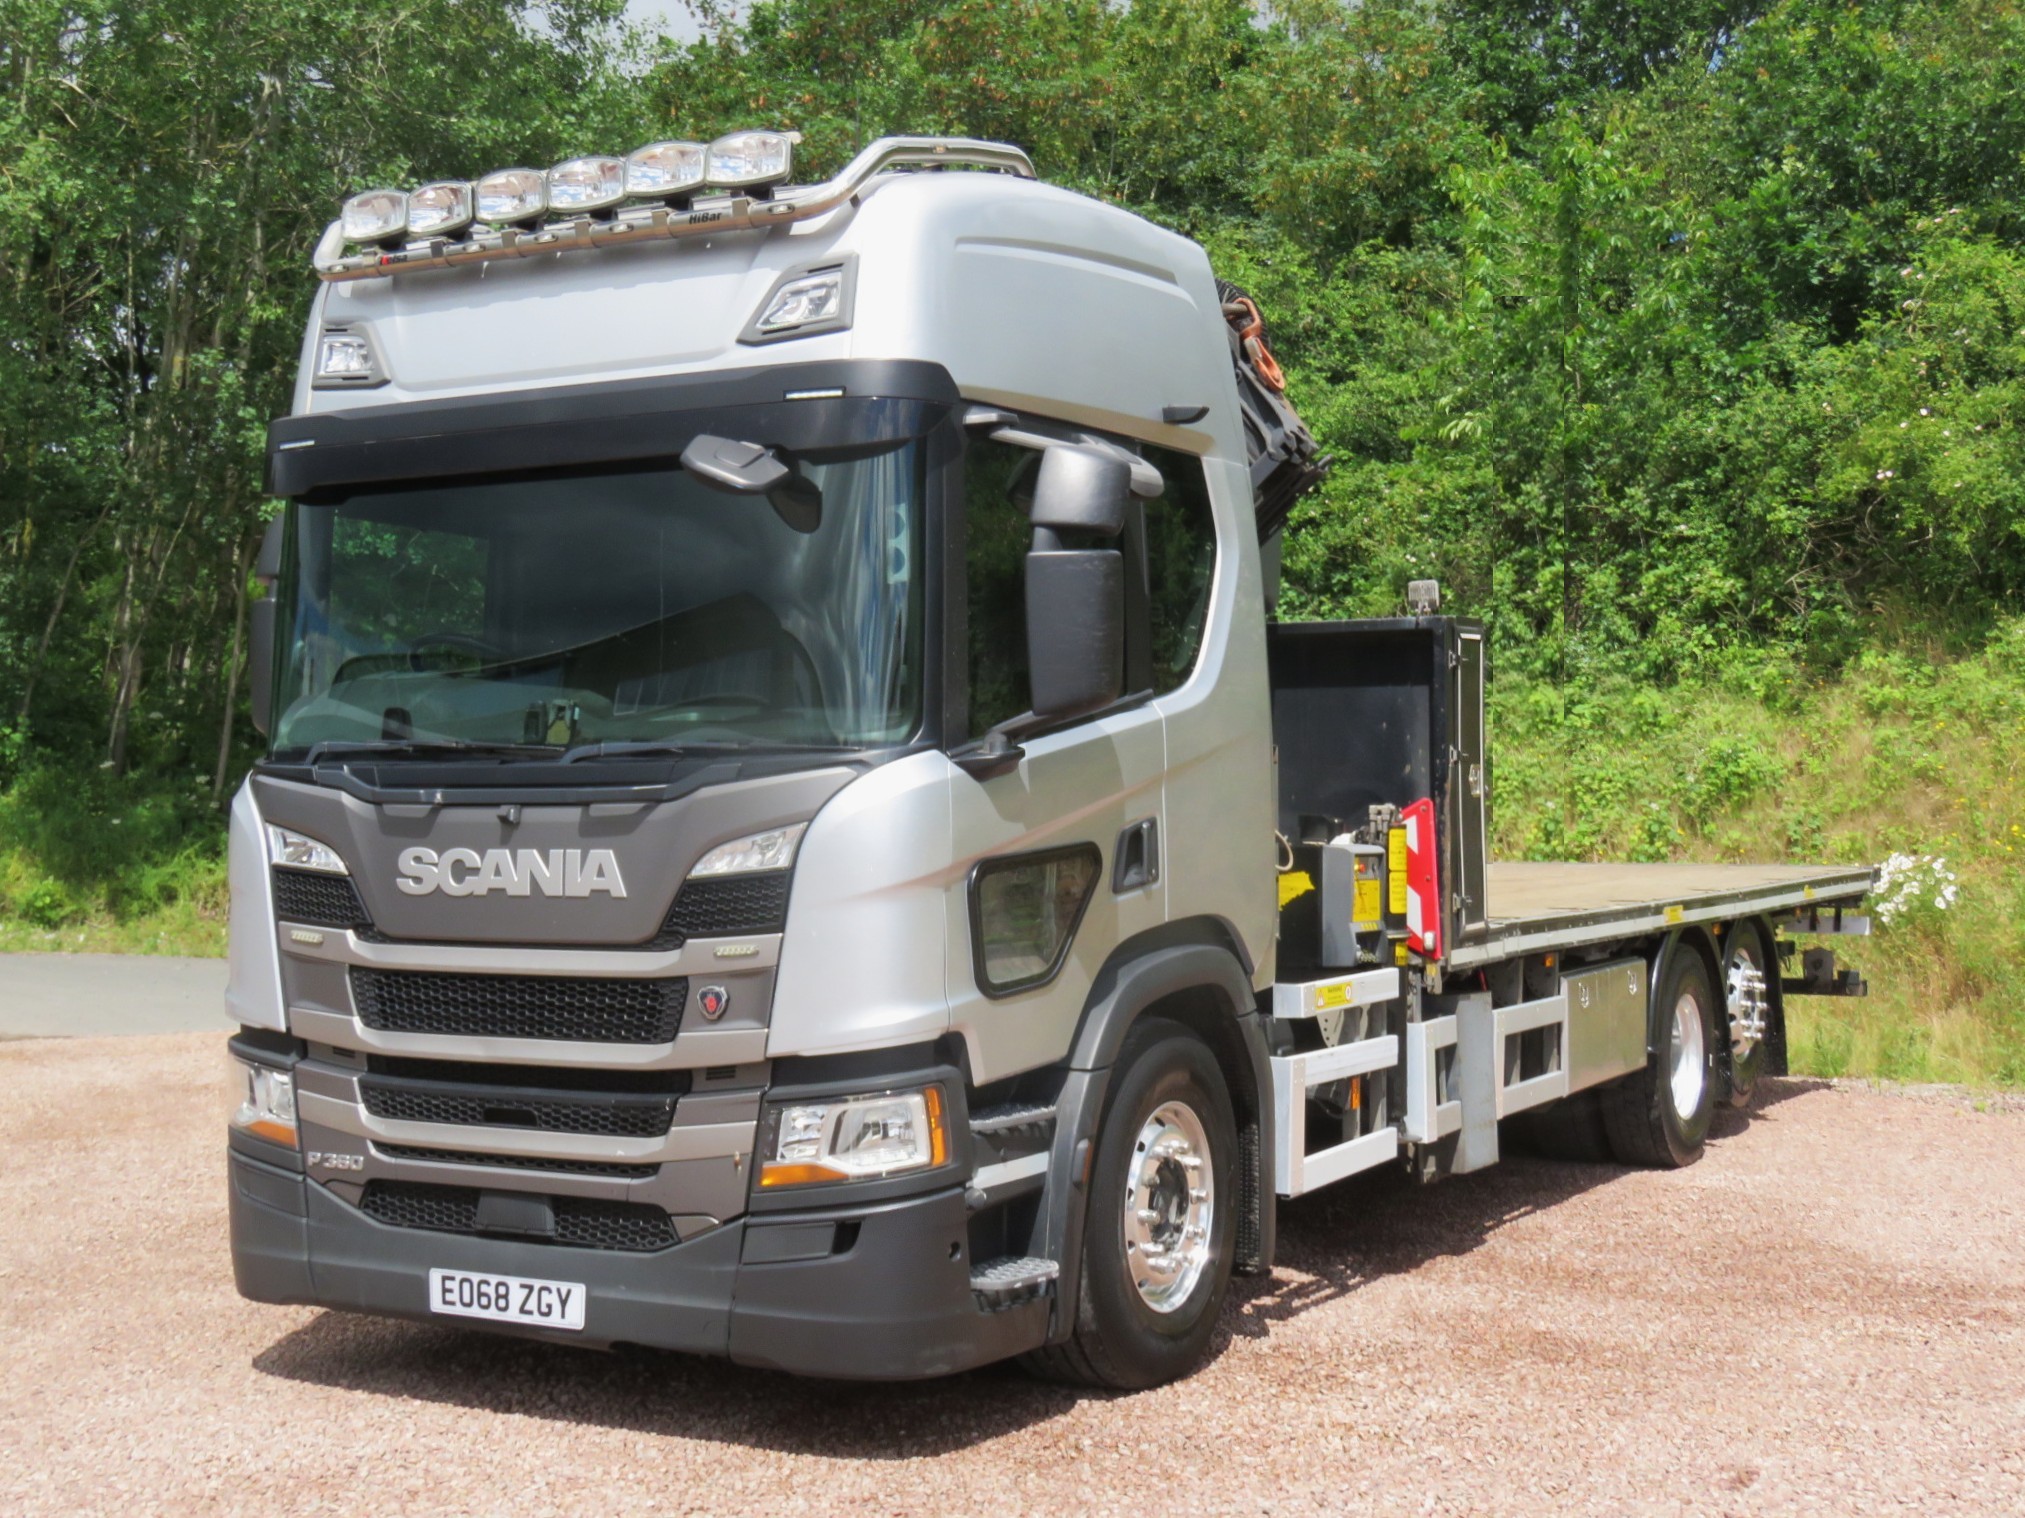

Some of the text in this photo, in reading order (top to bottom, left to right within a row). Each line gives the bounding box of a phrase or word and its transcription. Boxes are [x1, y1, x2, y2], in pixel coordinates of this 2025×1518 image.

[689, 212, 722, 225] HiBar
[396, 847, 627, 897] SCANIA
[308, 1151, 321, 1167] P
[441, 1275, 572, 1319] EO68 ZGY
